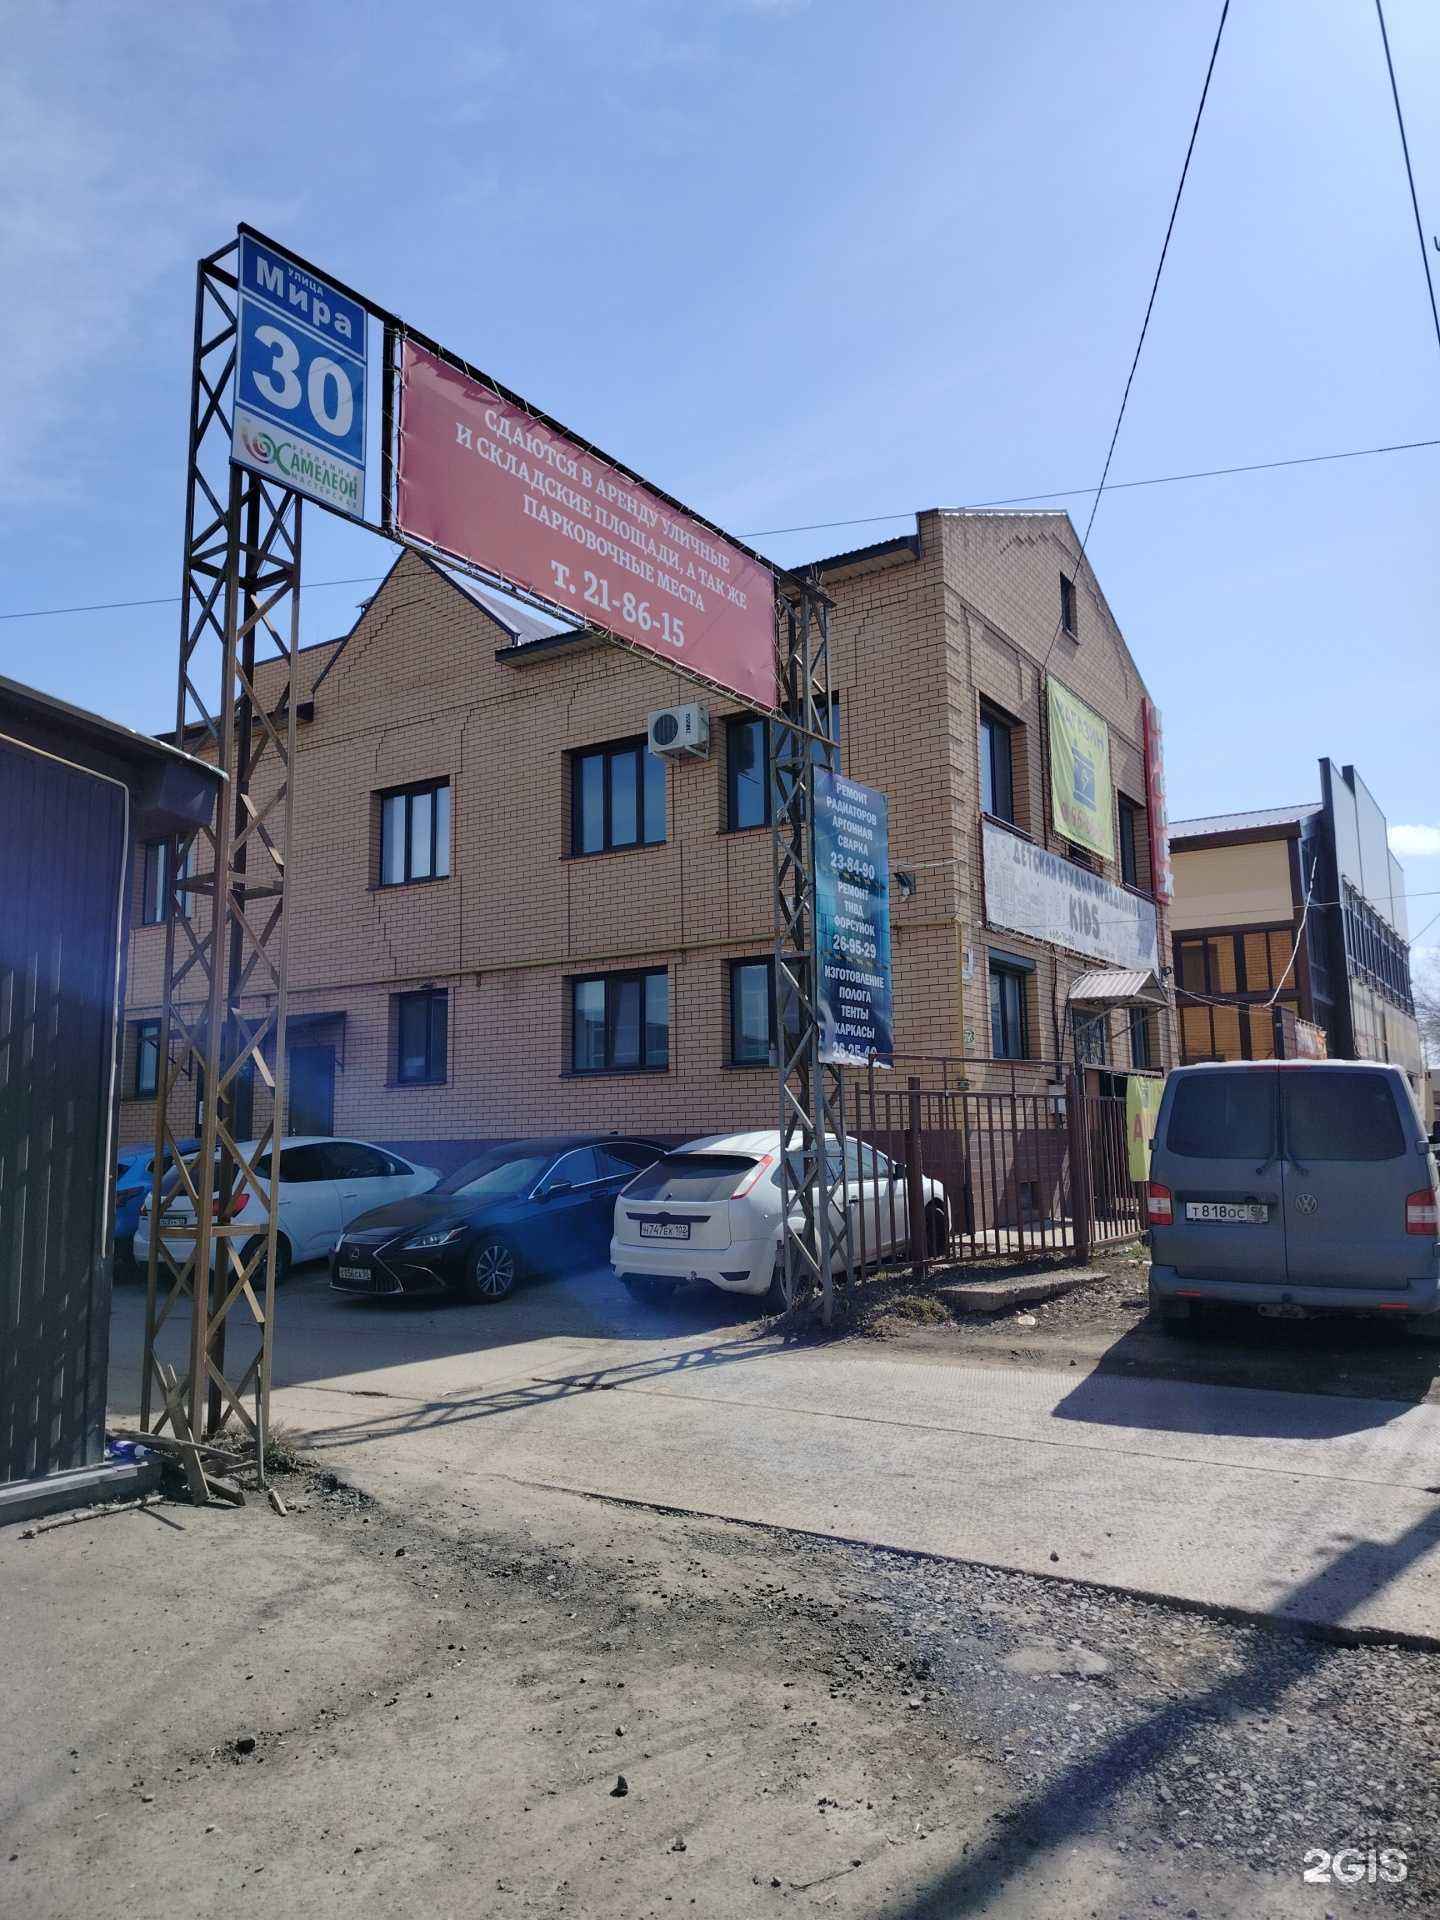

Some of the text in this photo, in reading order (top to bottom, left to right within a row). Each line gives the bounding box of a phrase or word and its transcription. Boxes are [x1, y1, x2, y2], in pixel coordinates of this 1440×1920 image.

[256, 255, 352, 339] Мира
[252, 325, 353, 437] 30
[455, 422, 473, 450] И
[476, 436, 593, 519] СКЛАДСКИЕ
[594, 504, 684, 575] ПЛОЩАДИ,
[686, 561, 697, 580] А
[484, 408, 731, 575] СДАЮТСЯ В АРЕНДУ УЛИЧНЫЕ
[523, 494, 705, 612] ПАРКОВОЧНЫЕ МЕСТА
[583, 570, 685, 648] 21-86-15
[836, 782, 868, 805] РЕМОНТ
[826, 795, 878, 826] РАДИАТОРОВ
[832, 815, 873, 841] АРГОННАЯ
[838, 834, 868, 857] СВАРКА
[830, 851, 875, 880] 23-84-90
[838, 881, 869, 900] РЕМОНТ
[834, 914, 875, 937] ФОРСУНОК
[833, 934, 877, 959] 26-95-29
[824, 965, 885, 989] ИЗГОТОВЛЕНИЕ
[839, 986, 872, 1003] ПОЛОГА
[841, 1005, 869, 1021] ТЕНТЫ
